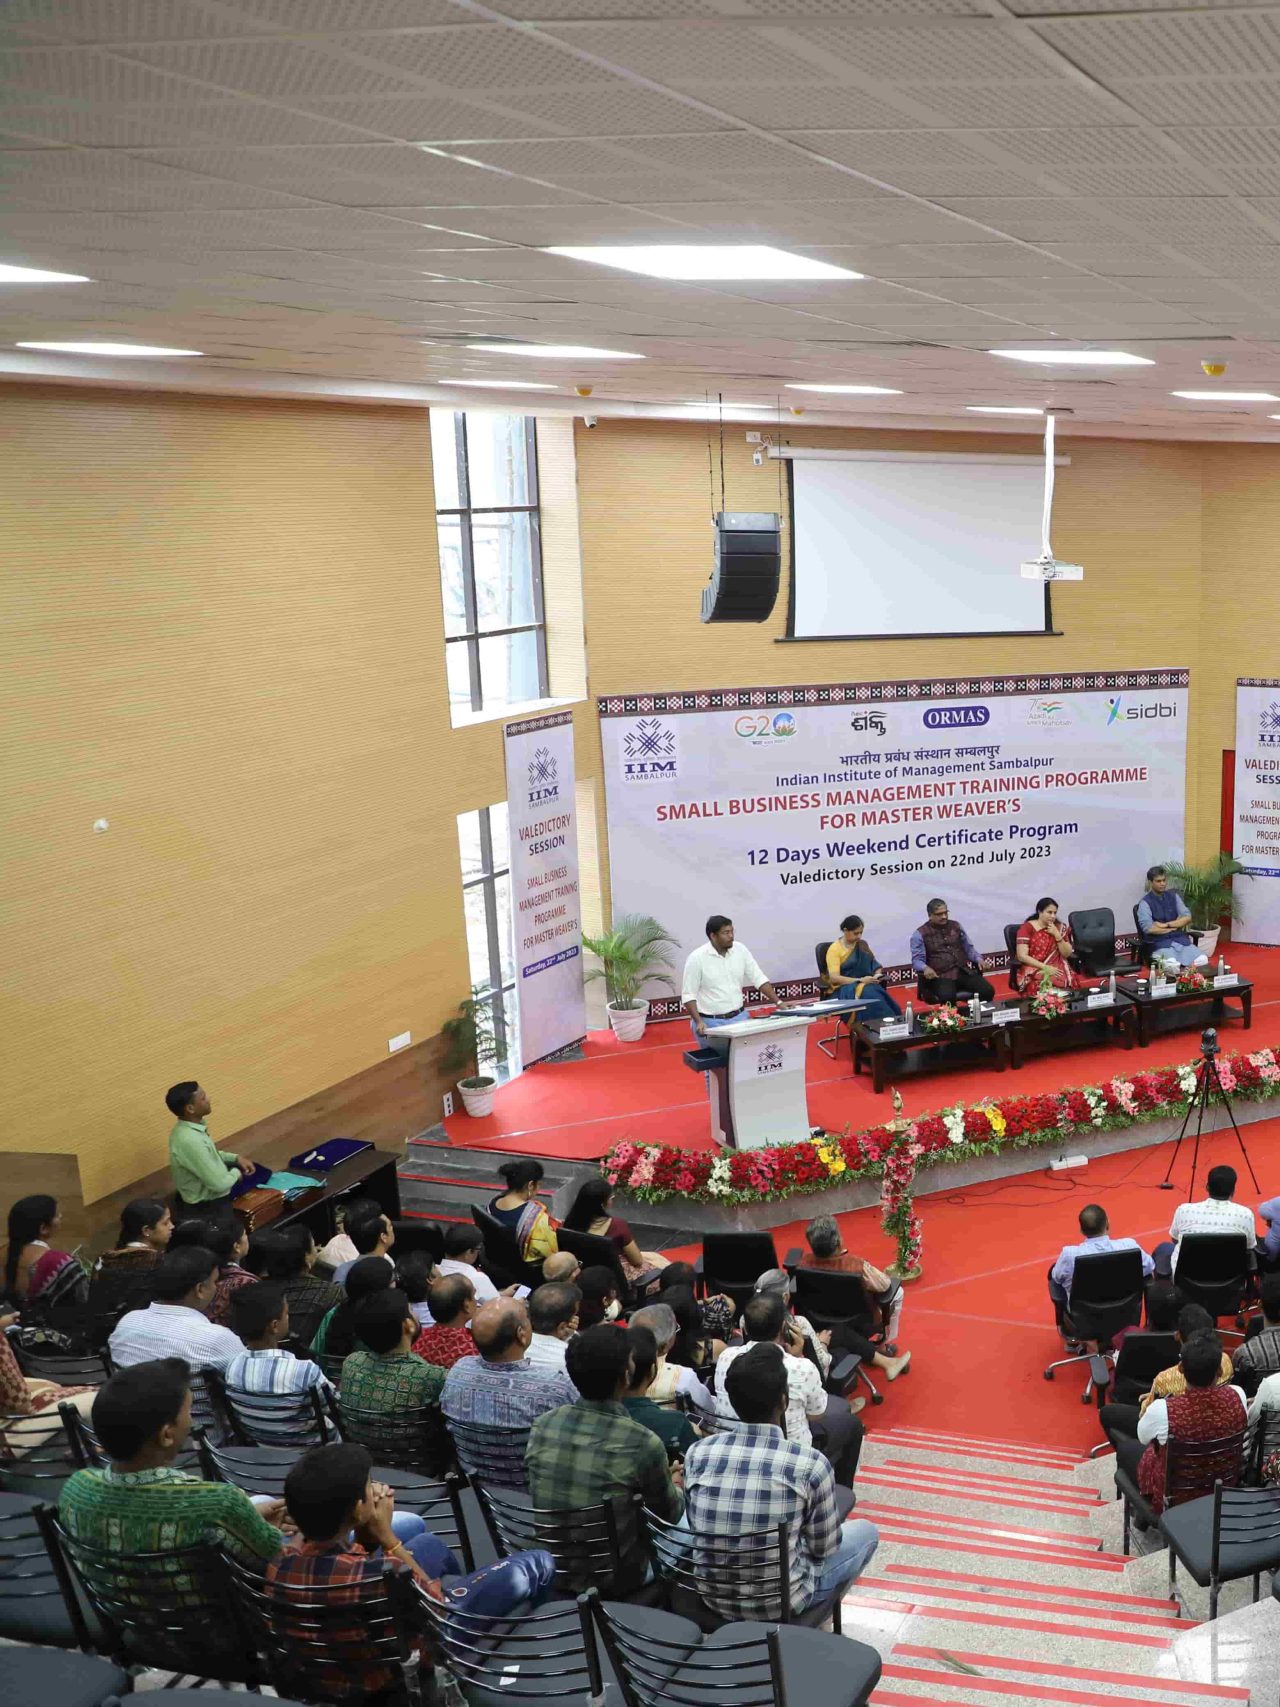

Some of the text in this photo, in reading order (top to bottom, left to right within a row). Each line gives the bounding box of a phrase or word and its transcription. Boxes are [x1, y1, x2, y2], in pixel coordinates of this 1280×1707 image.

[928, 709, 985, 726] ORMAS
[1126, 702, 1177, 719] sidbi
[840, 745, 1001, 766] भारतीय प्रबंध संस्थान सम्बलपुर
[624, 761, 677, 774] IIM
[625, 771, 678, 781] SAMBALPUR
[776, 756, 1054, 787] Indian Institute of Management Sambalpur
[528, 785, 559, 803] IIM
[657, 767, 1148, 821] SMALL BUSINESS MANAGEMENT TRAINING PROGRAMME
[1251, 800, 1271, 810] SMALL
[819, 798, 1022, 831] FOR MASTER WEAVER'S
[518, 814, 571, 841] VALEDICTORY
[529, 834, 565, 857] SESSION
[747, 820, 1079, 866] 12 Days Weekend Certificate Program
[1242, 844, 1254, 854] FOR
[1255, 846, 1280, 856] MASTER
[780, 845, 1052, 886] Valedictory Session on 22nd July 2023
[527, 865, 568, 890] SMALL BUSINESS
[519, 881, 578, 912] MANAGEMENT TRAINING
[534, 906, 566, 927] PROGRAMME
[523, 936, 535, 951] FOR
[534, 927, 555, 946] MASTER
